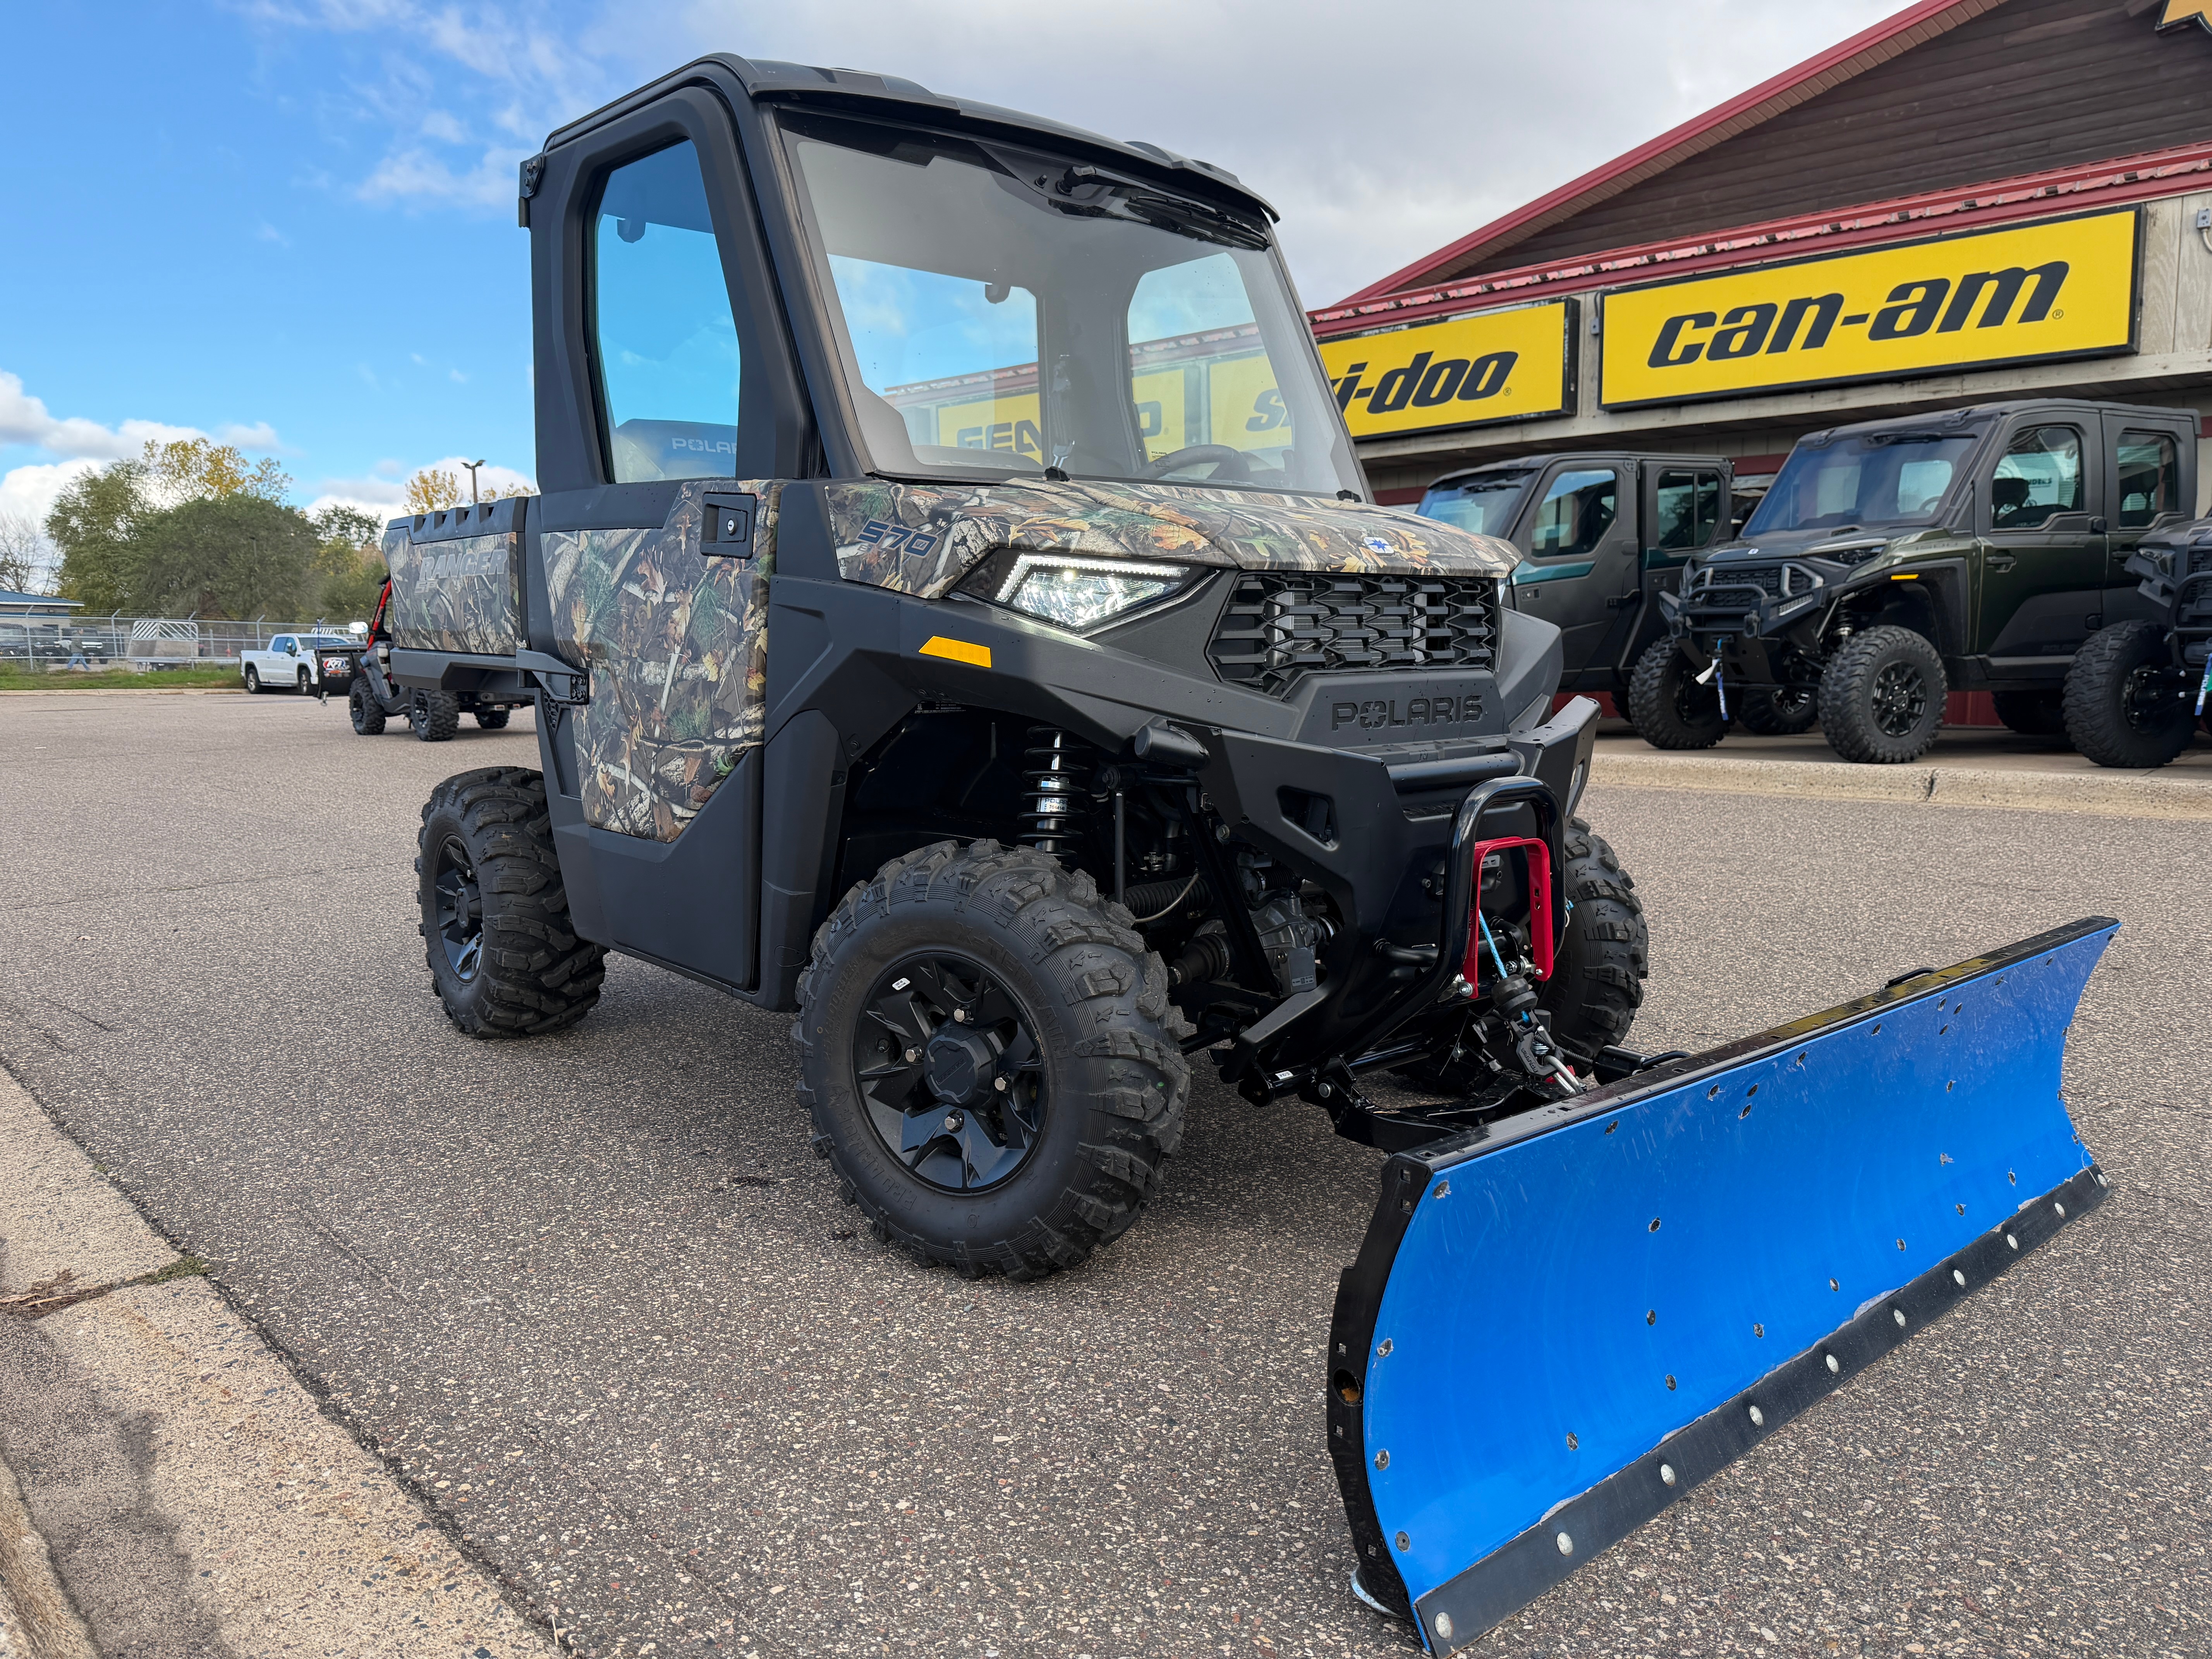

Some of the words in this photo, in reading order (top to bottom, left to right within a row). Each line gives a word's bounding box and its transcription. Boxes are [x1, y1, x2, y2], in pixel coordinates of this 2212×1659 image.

[1647, 261, 2069, 368] can-am
[1245, 351, 1518, 432] Si-doo
[672, 438, 737, 454] POLA
[856, 519, 939, 559] 570
[419, 548, 508, 581] RANGER
[1331, 695, 1483, 732] POLARIS
